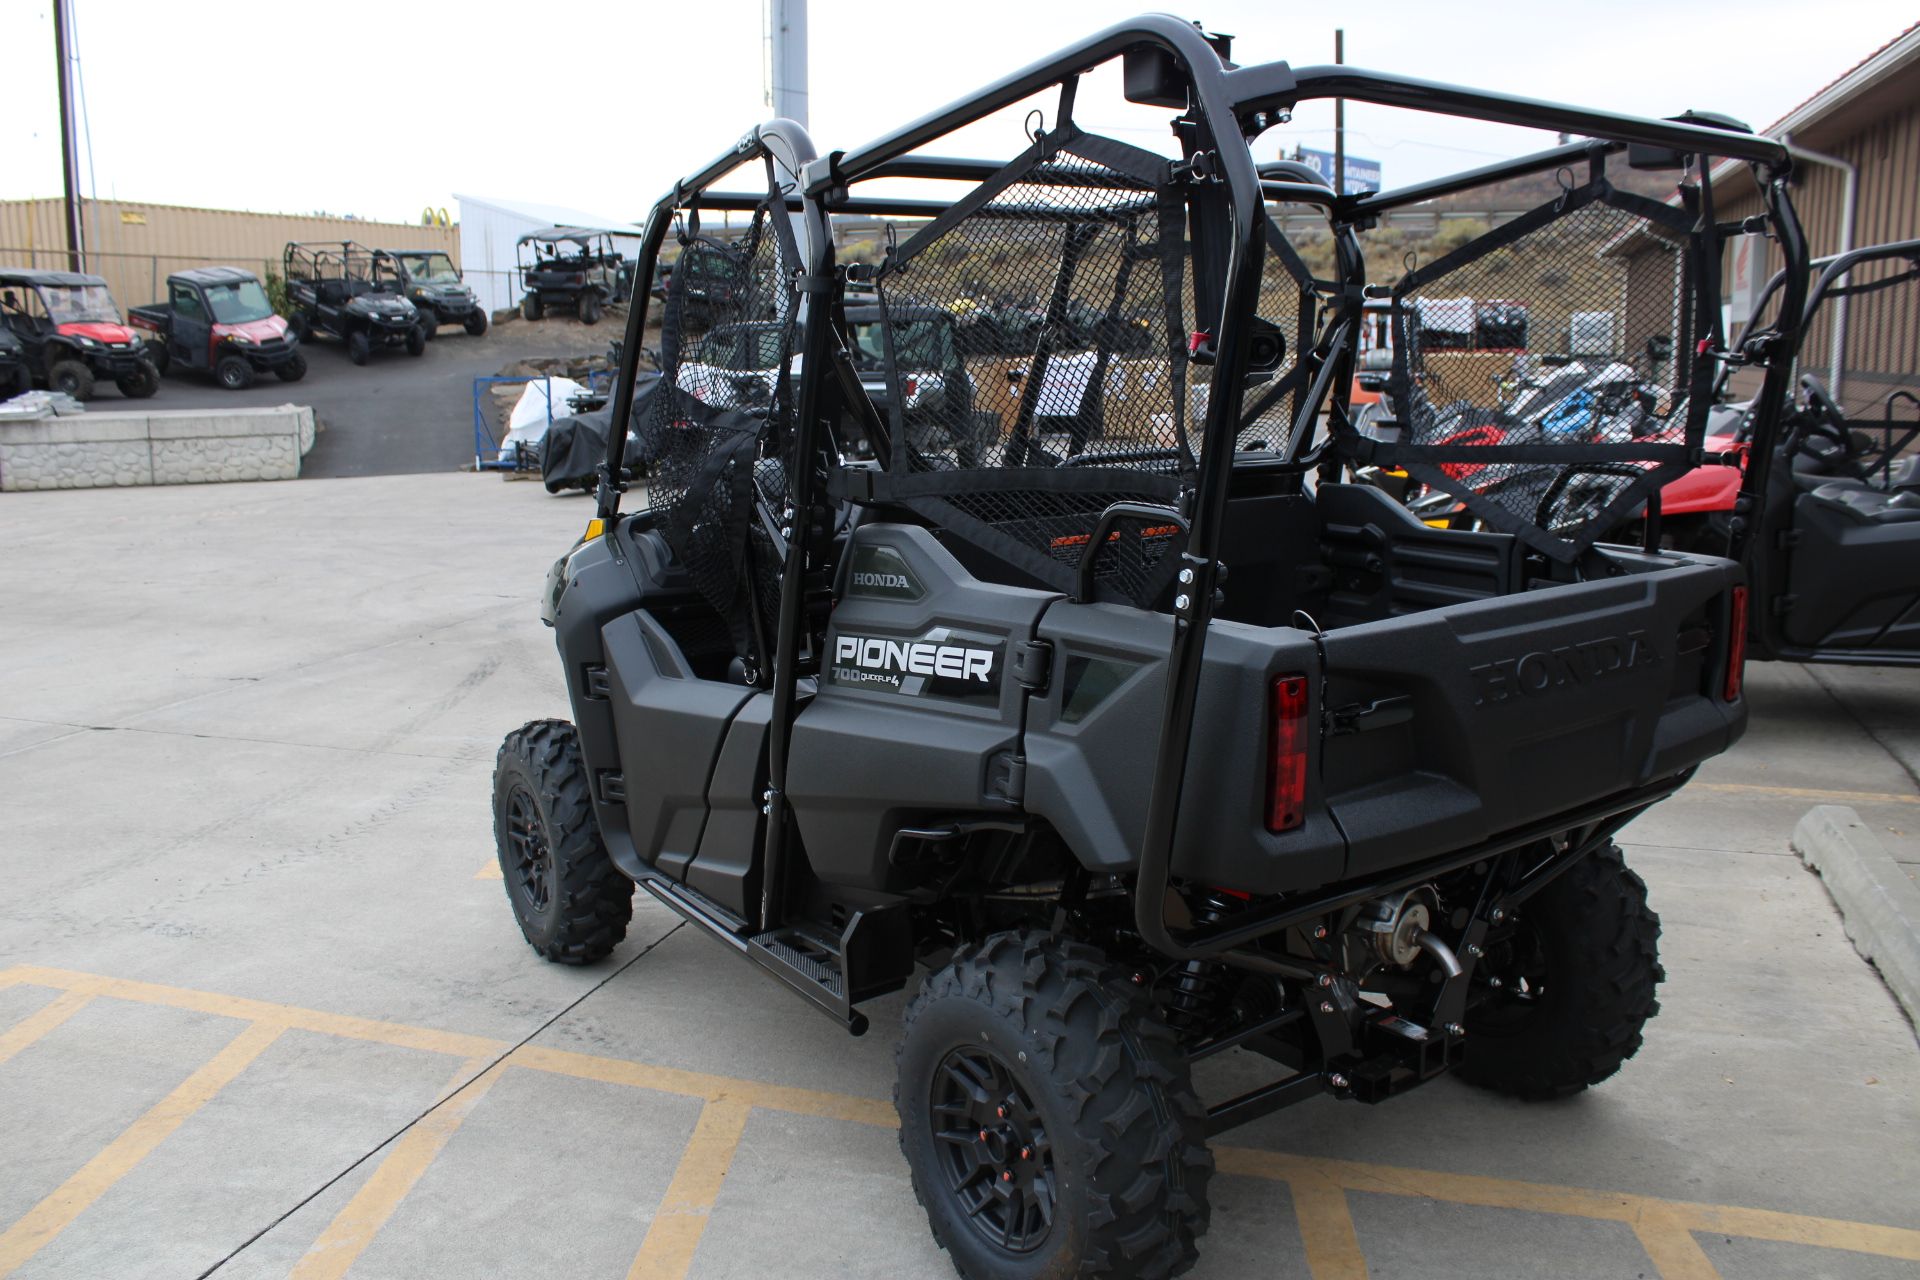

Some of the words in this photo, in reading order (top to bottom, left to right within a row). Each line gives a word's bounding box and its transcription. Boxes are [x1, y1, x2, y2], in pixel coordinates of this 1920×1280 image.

[853, 572, 910, 588] HONDA
[831, 666, 861, 681] 700
[835, 636, 994, 683] PIONEER
[1469, 629, 1664, 706] HONDA
